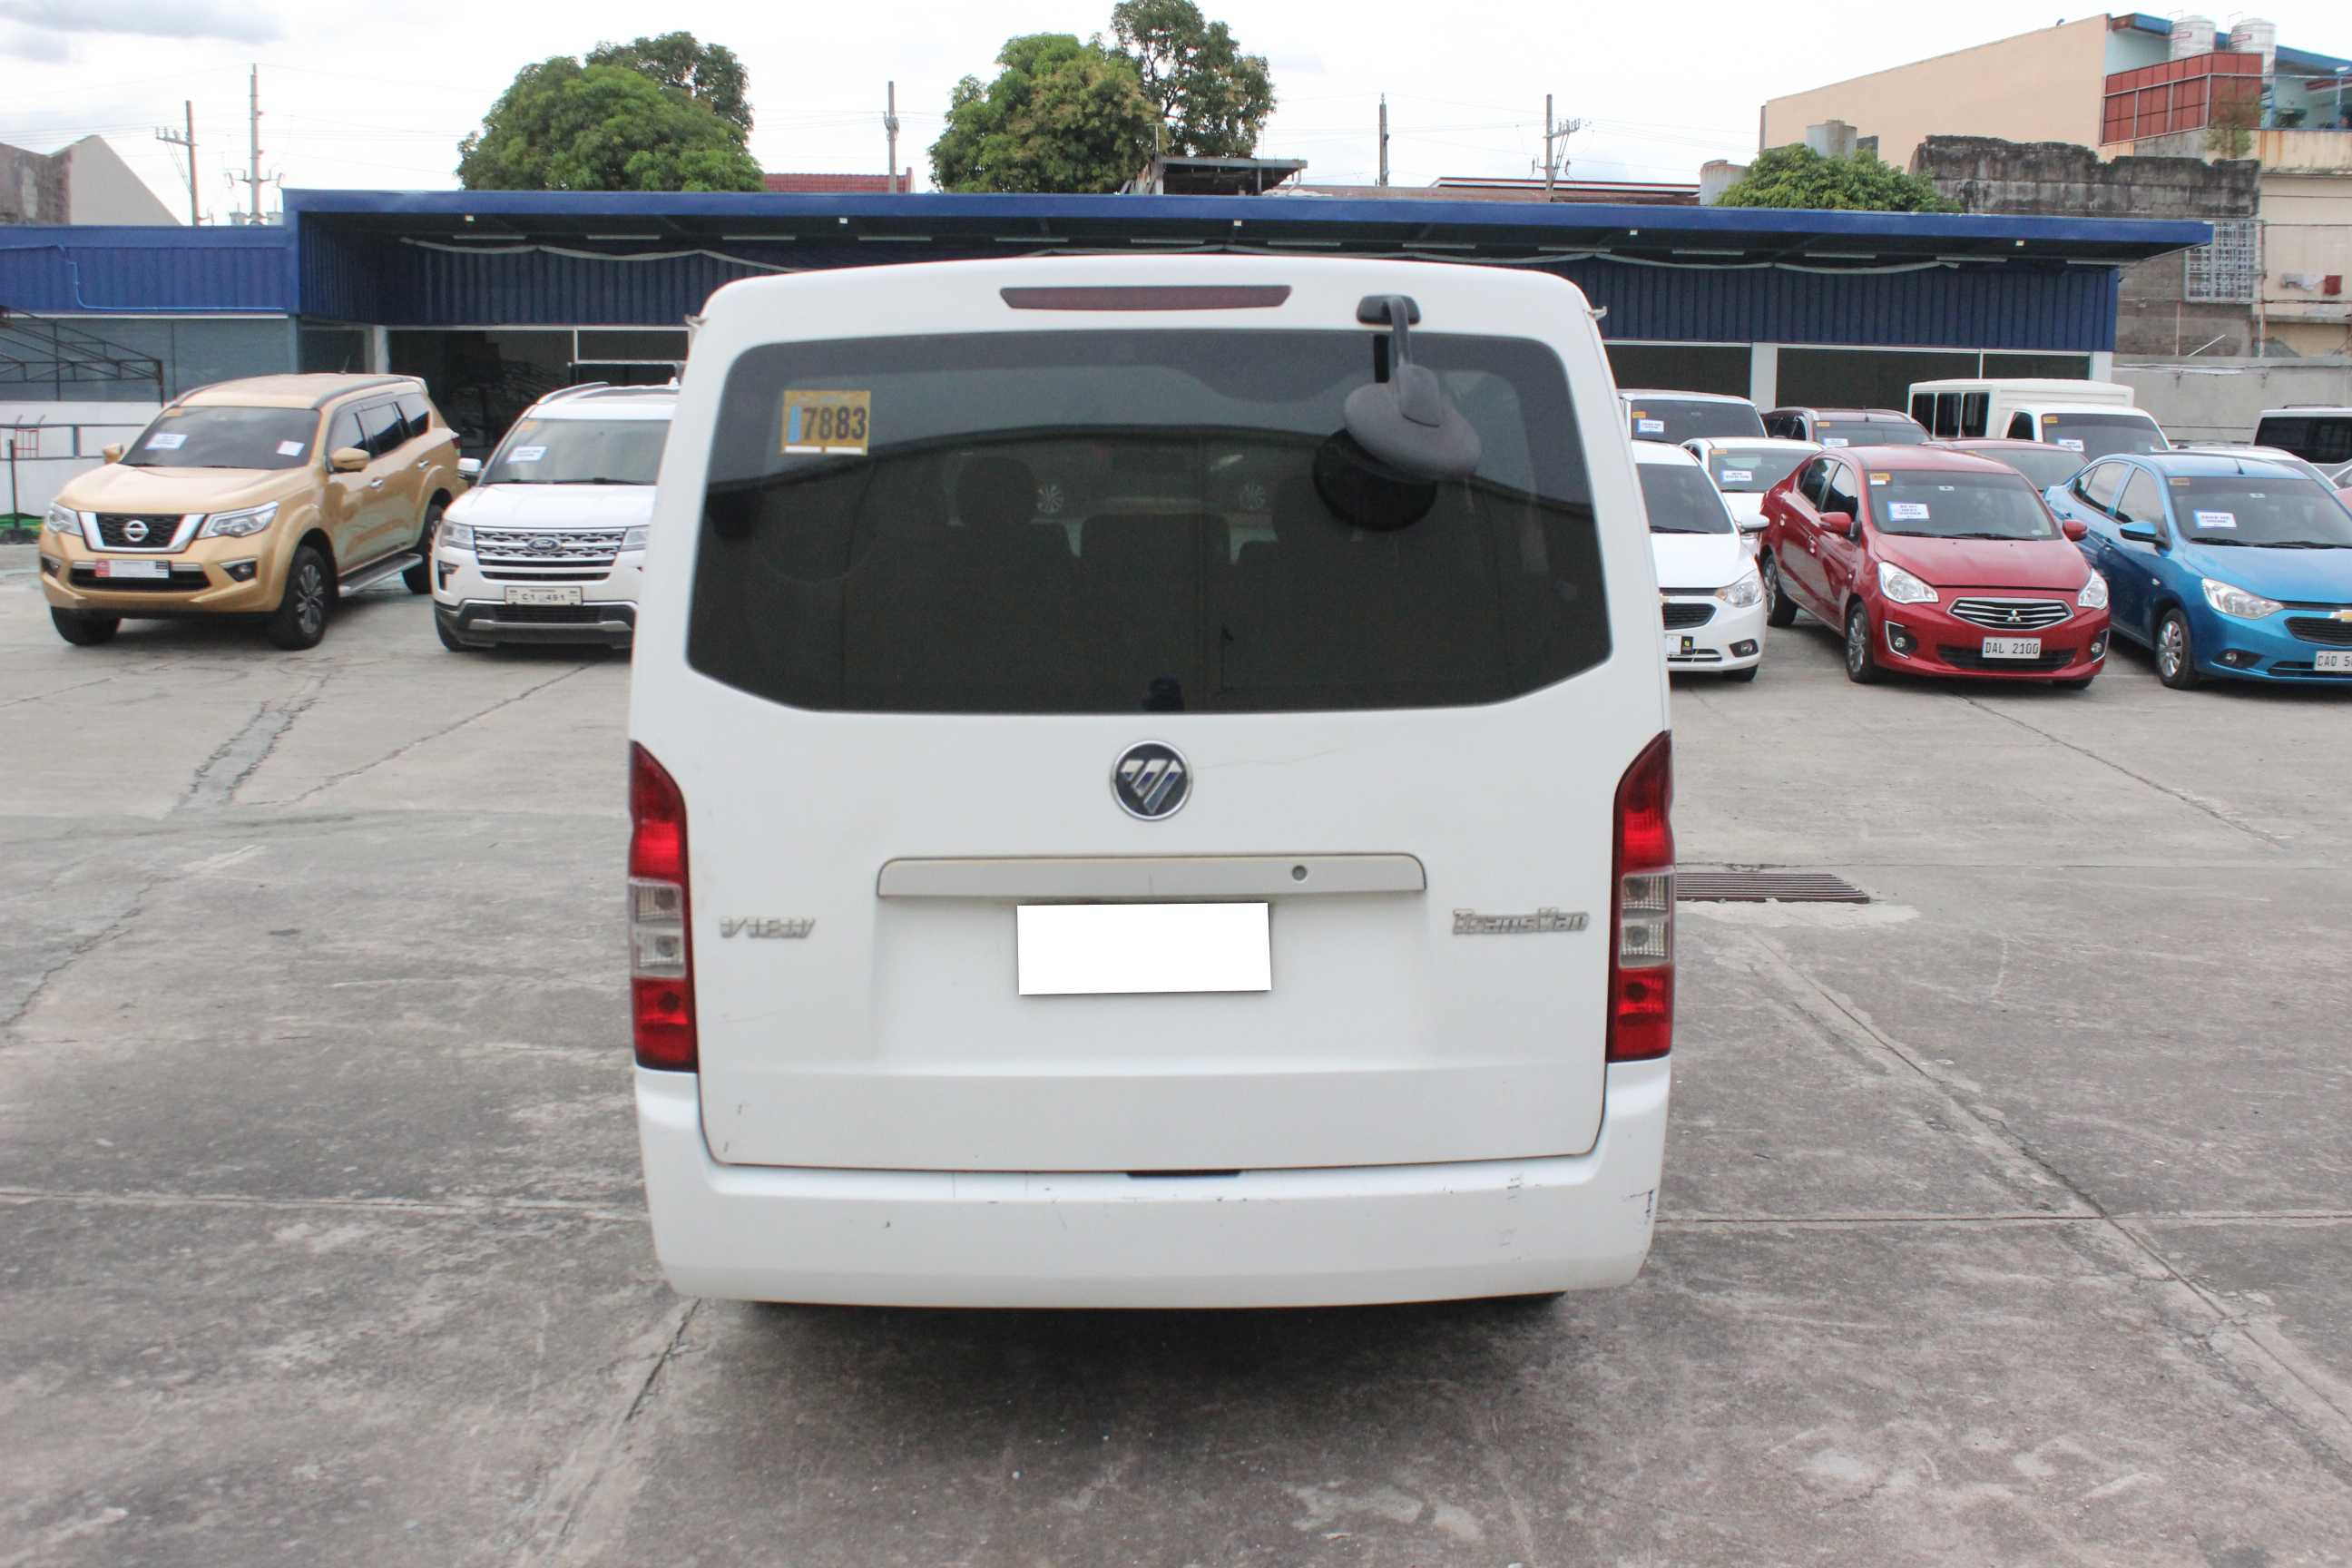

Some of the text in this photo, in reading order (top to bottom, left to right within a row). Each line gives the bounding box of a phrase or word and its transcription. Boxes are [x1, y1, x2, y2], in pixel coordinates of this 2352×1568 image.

[1985, 642, 2039, 654] DAL 2100
[2344, 655, 2352, 667] 5
[720, 916, 816, 939] VIEW
